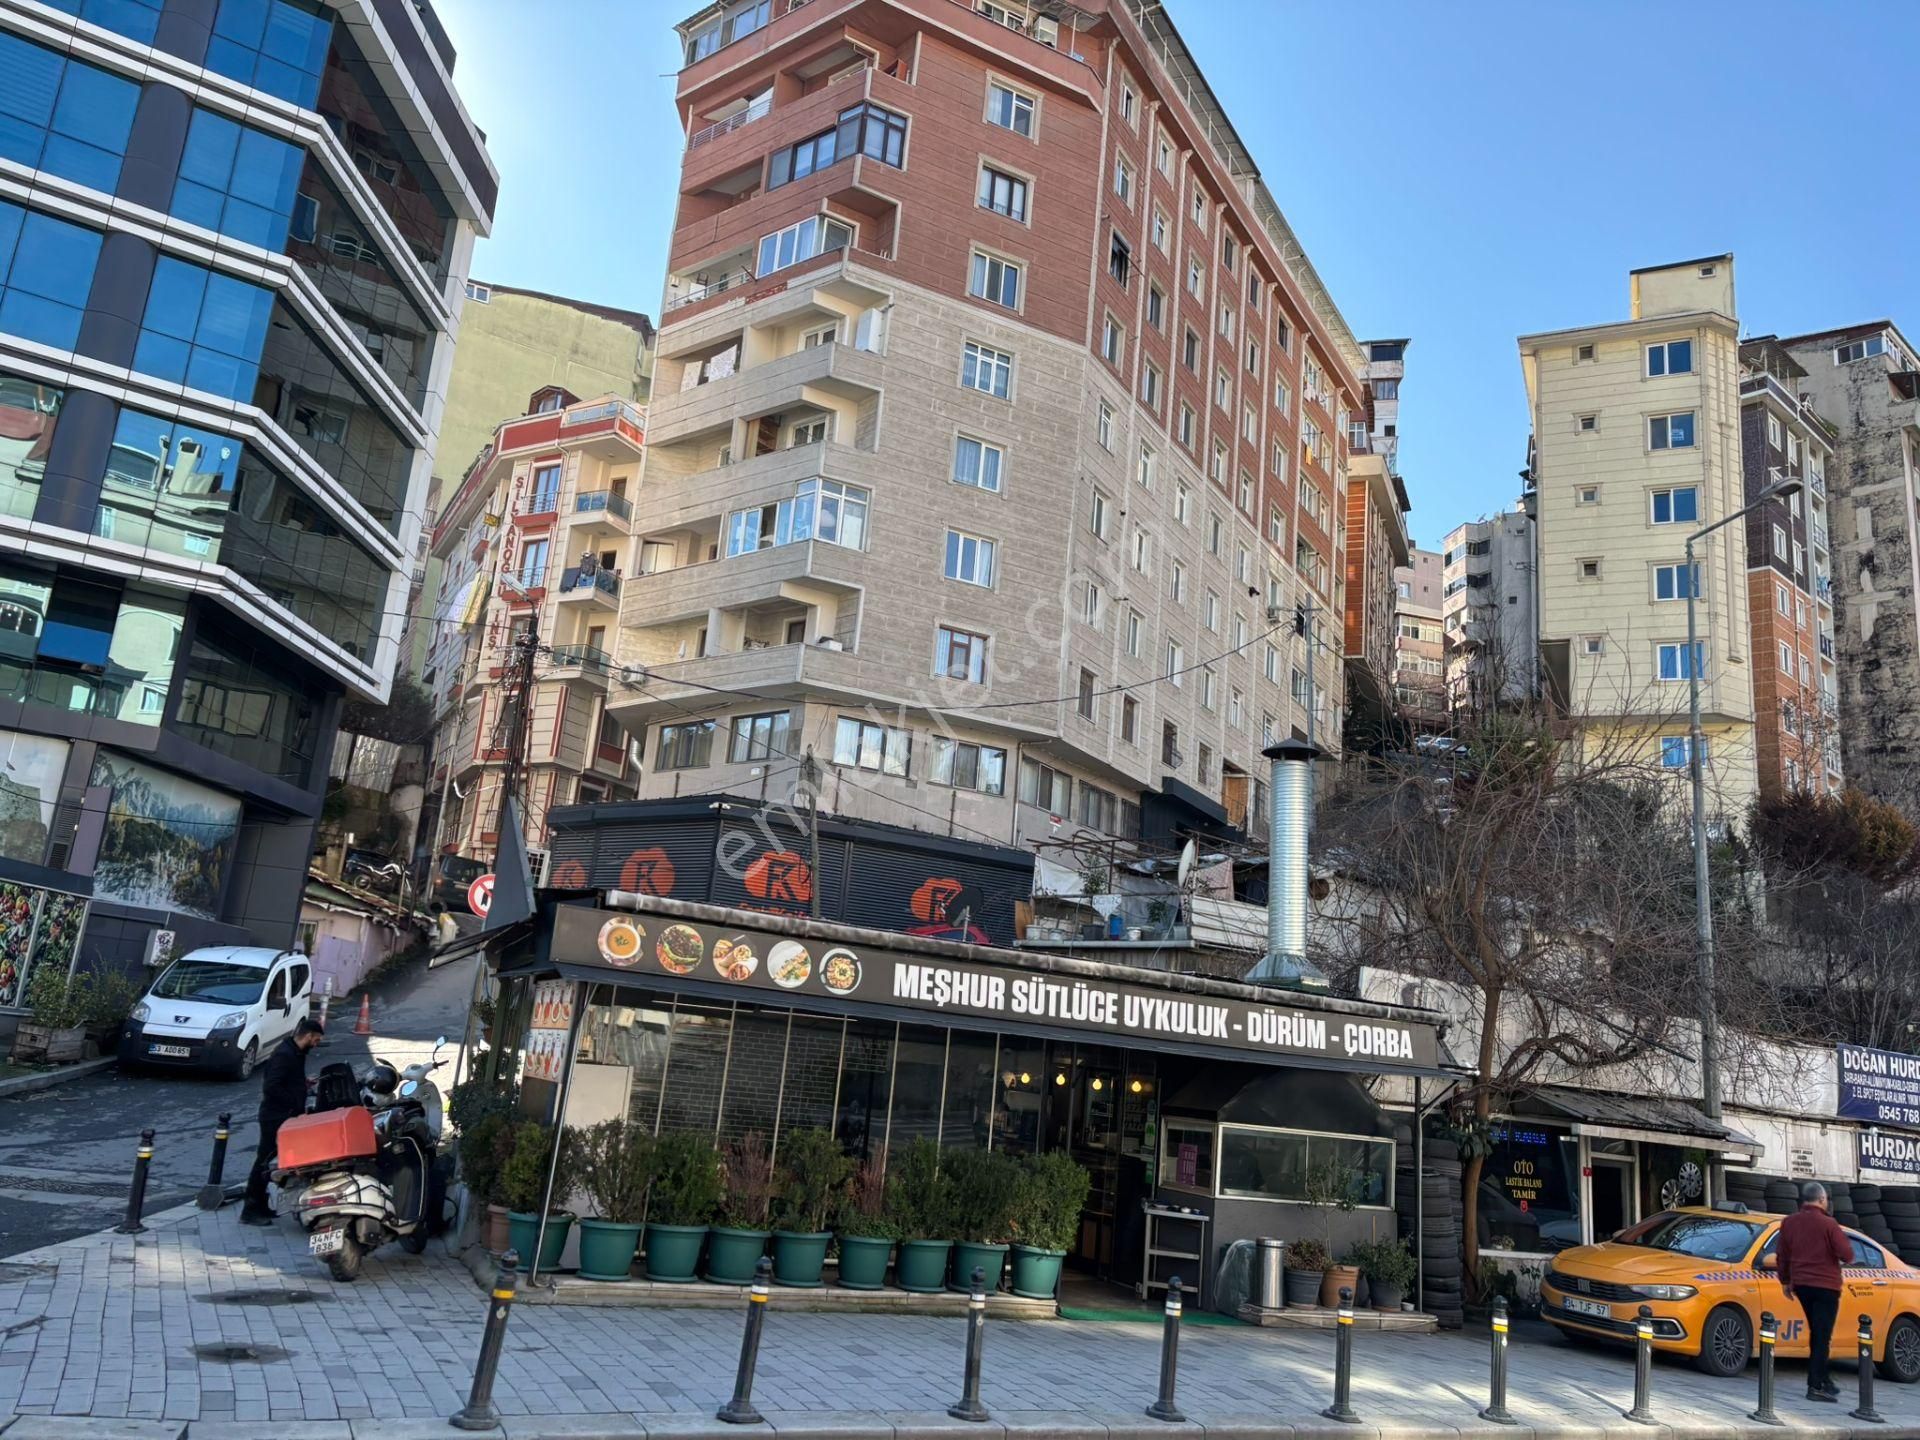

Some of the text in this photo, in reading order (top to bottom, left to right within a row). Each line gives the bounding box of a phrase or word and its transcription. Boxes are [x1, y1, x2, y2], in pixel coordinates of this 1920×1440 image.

[893, 962, 1006, 1008] MEŞHUR
[1011, 976, 1119, 1025] SÜTLÜCE
[1123, 994, 1229, 1039] UYKULUK
[1247, 1008, 1327, 1050] DÜRÜM
[1343, 1022, 1414, 1059] ÇORBA
[1843, 1048, 1887, 1075] DOĞAN
[1878, 1104, 1920, 1124] 0545 768
[1513, 1160, 1534, 1175] OTO
[1870, 1157, 1888, 1169] 0545
[1511, 1188, 1537, 1200] TAMİR
